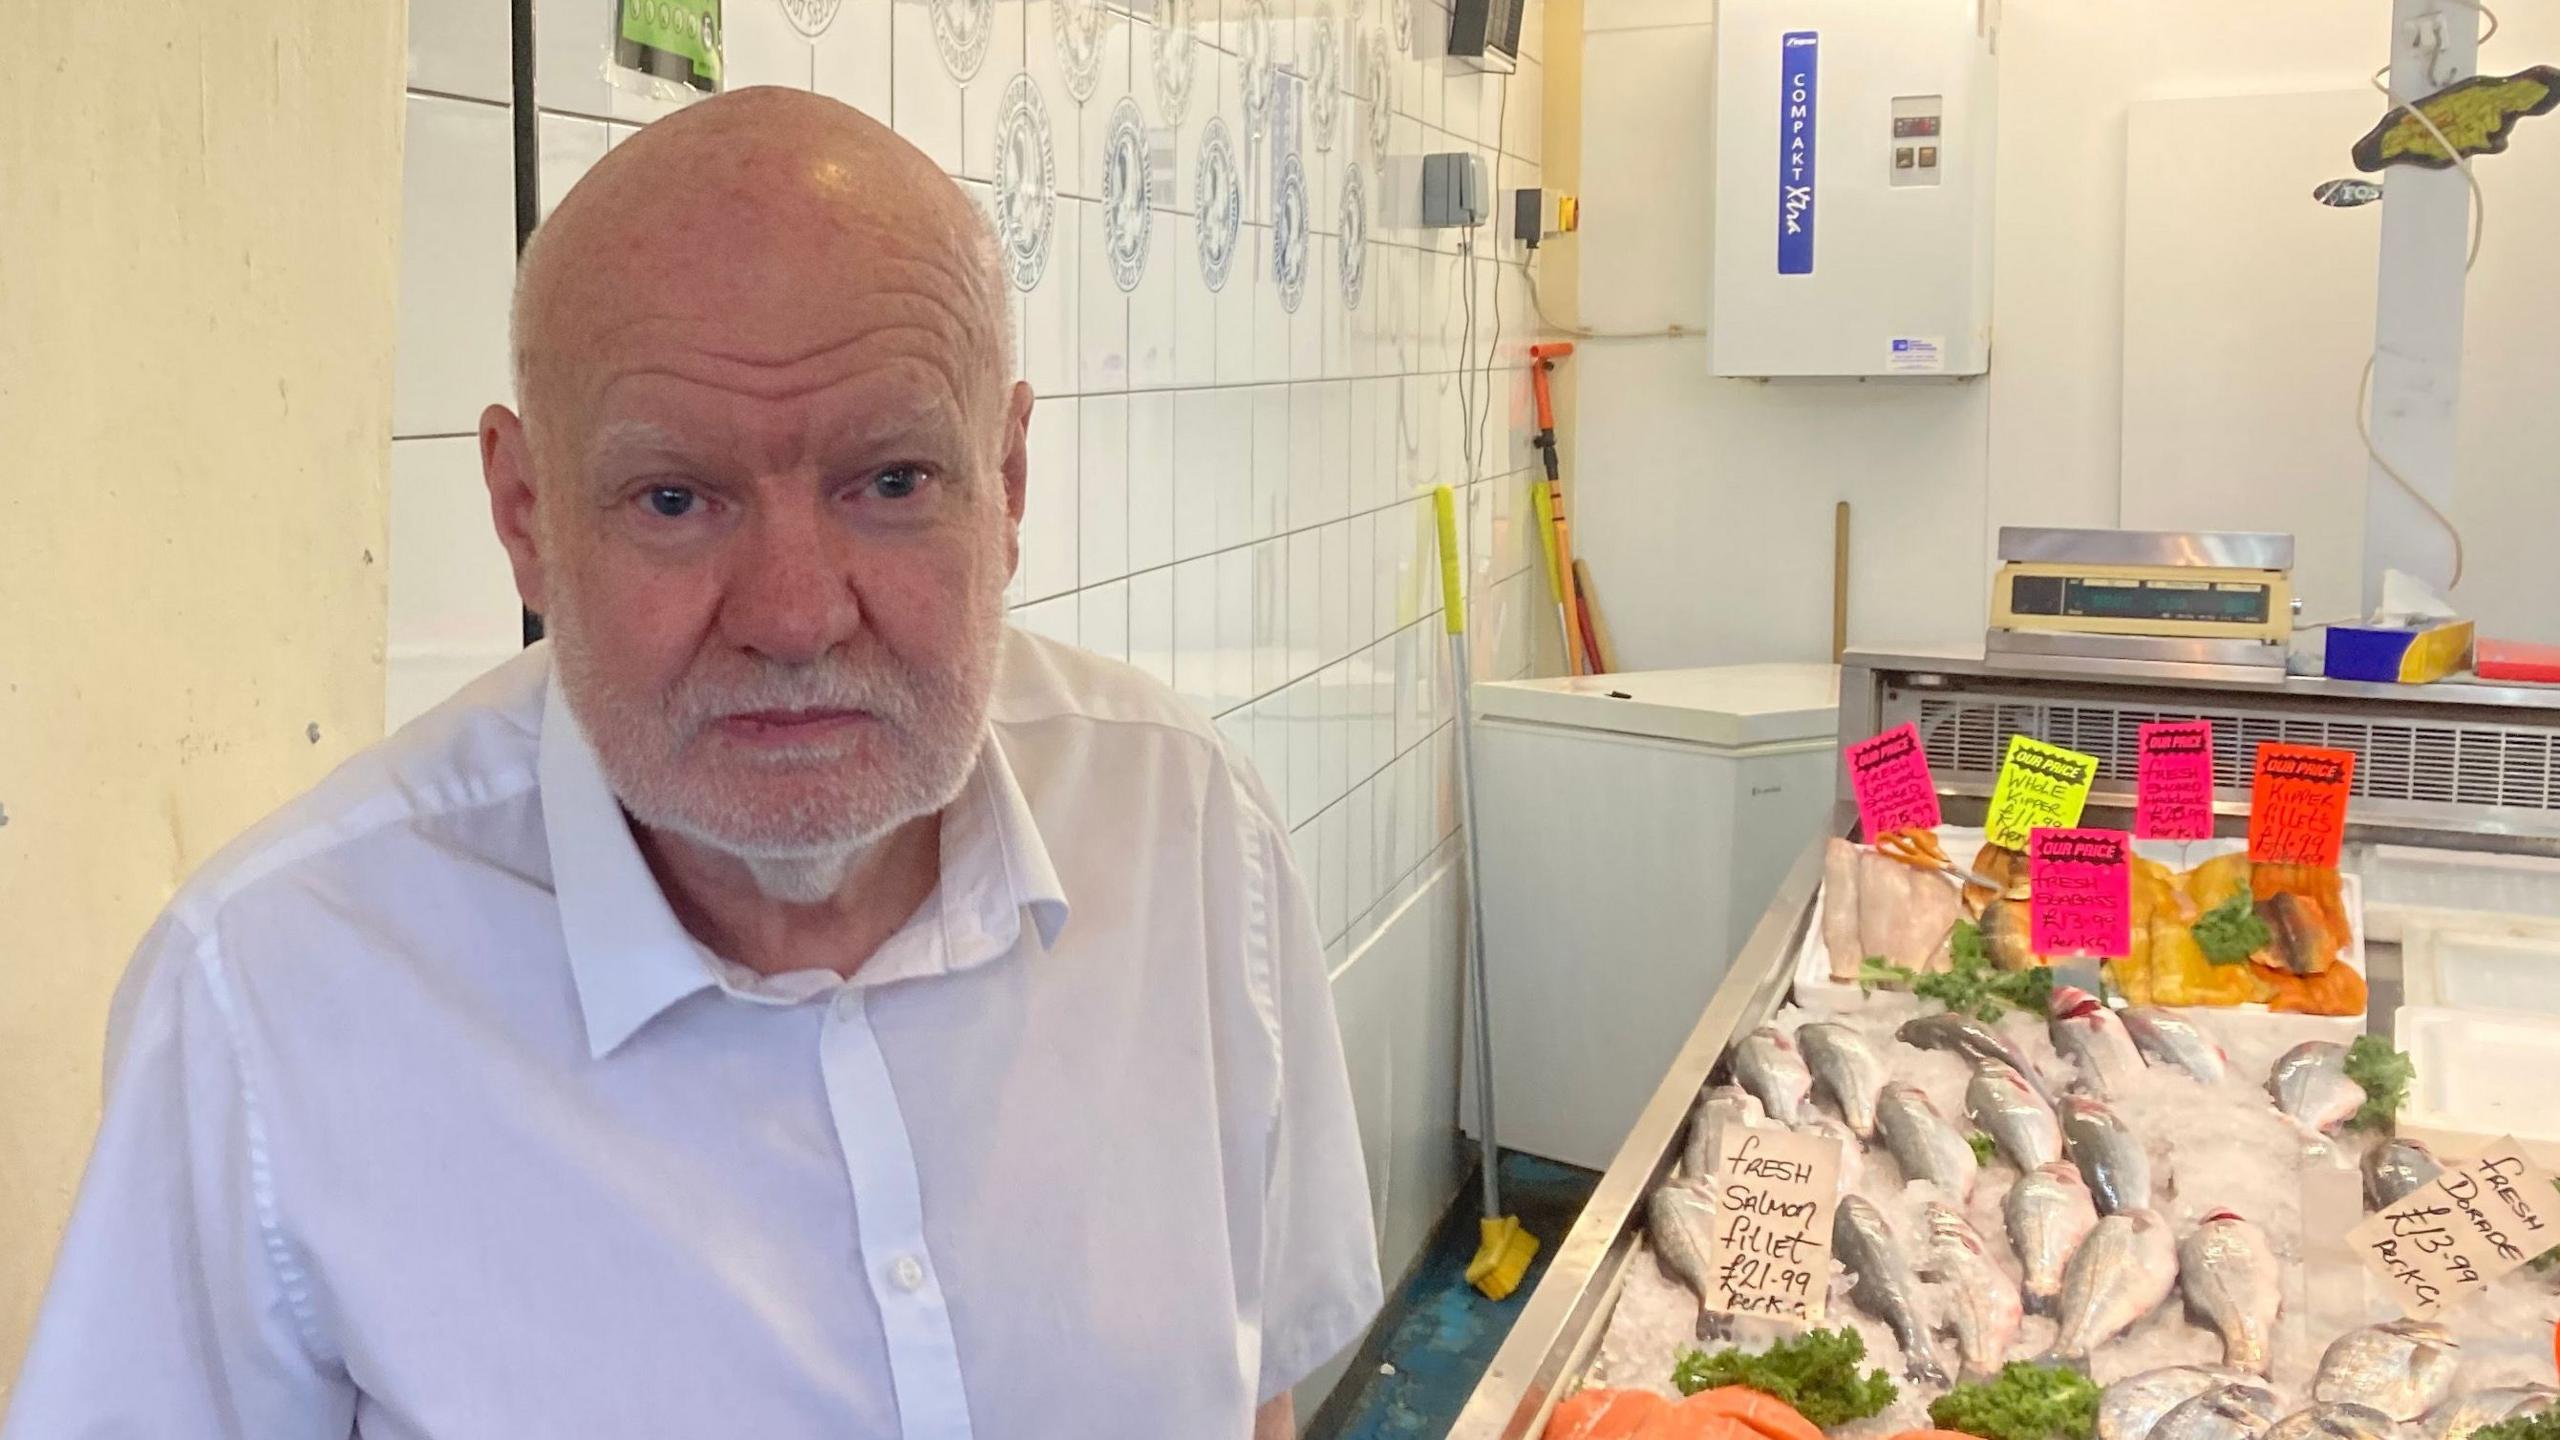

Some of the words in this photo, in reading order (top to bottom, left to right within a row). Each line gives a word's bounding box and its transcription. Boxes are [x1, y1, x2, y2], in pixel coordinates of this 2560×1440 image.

[1790, 73, 1807, 181] COMPAKT
[1858, 749, 1880, 767] OUR
[1880, 736, 1910, 759] PRICE
[2150, 736, 2172, 749] OUR
[2172, 735, 2202, 748] PRICE
[2015, 751, 2043, 768] OUR
[2042, 759, 2082, 779] PRICE
[2266, 759, 2296, 773] OUR
[2296, 762, 2338, 778] PRICE
[2008, 768, 2068, 800] WHOLE
[2269, 783, 2335, 809] KIPPER
[2006, 790, 2063, 817] KIPPER
[2043, 841, 2073, 855] OUR
[2073, 843, 2118, 858] PRICE
[2035, 892, 2118, 909] SEABASS
[2042, 908, 2117, 931] £13.99
[2436, 1171, 2526, 1261] DORADE
[2384, 1206, 2479, 1284] £13.99
[1720, 1253, 1811, 1296] £21.99
